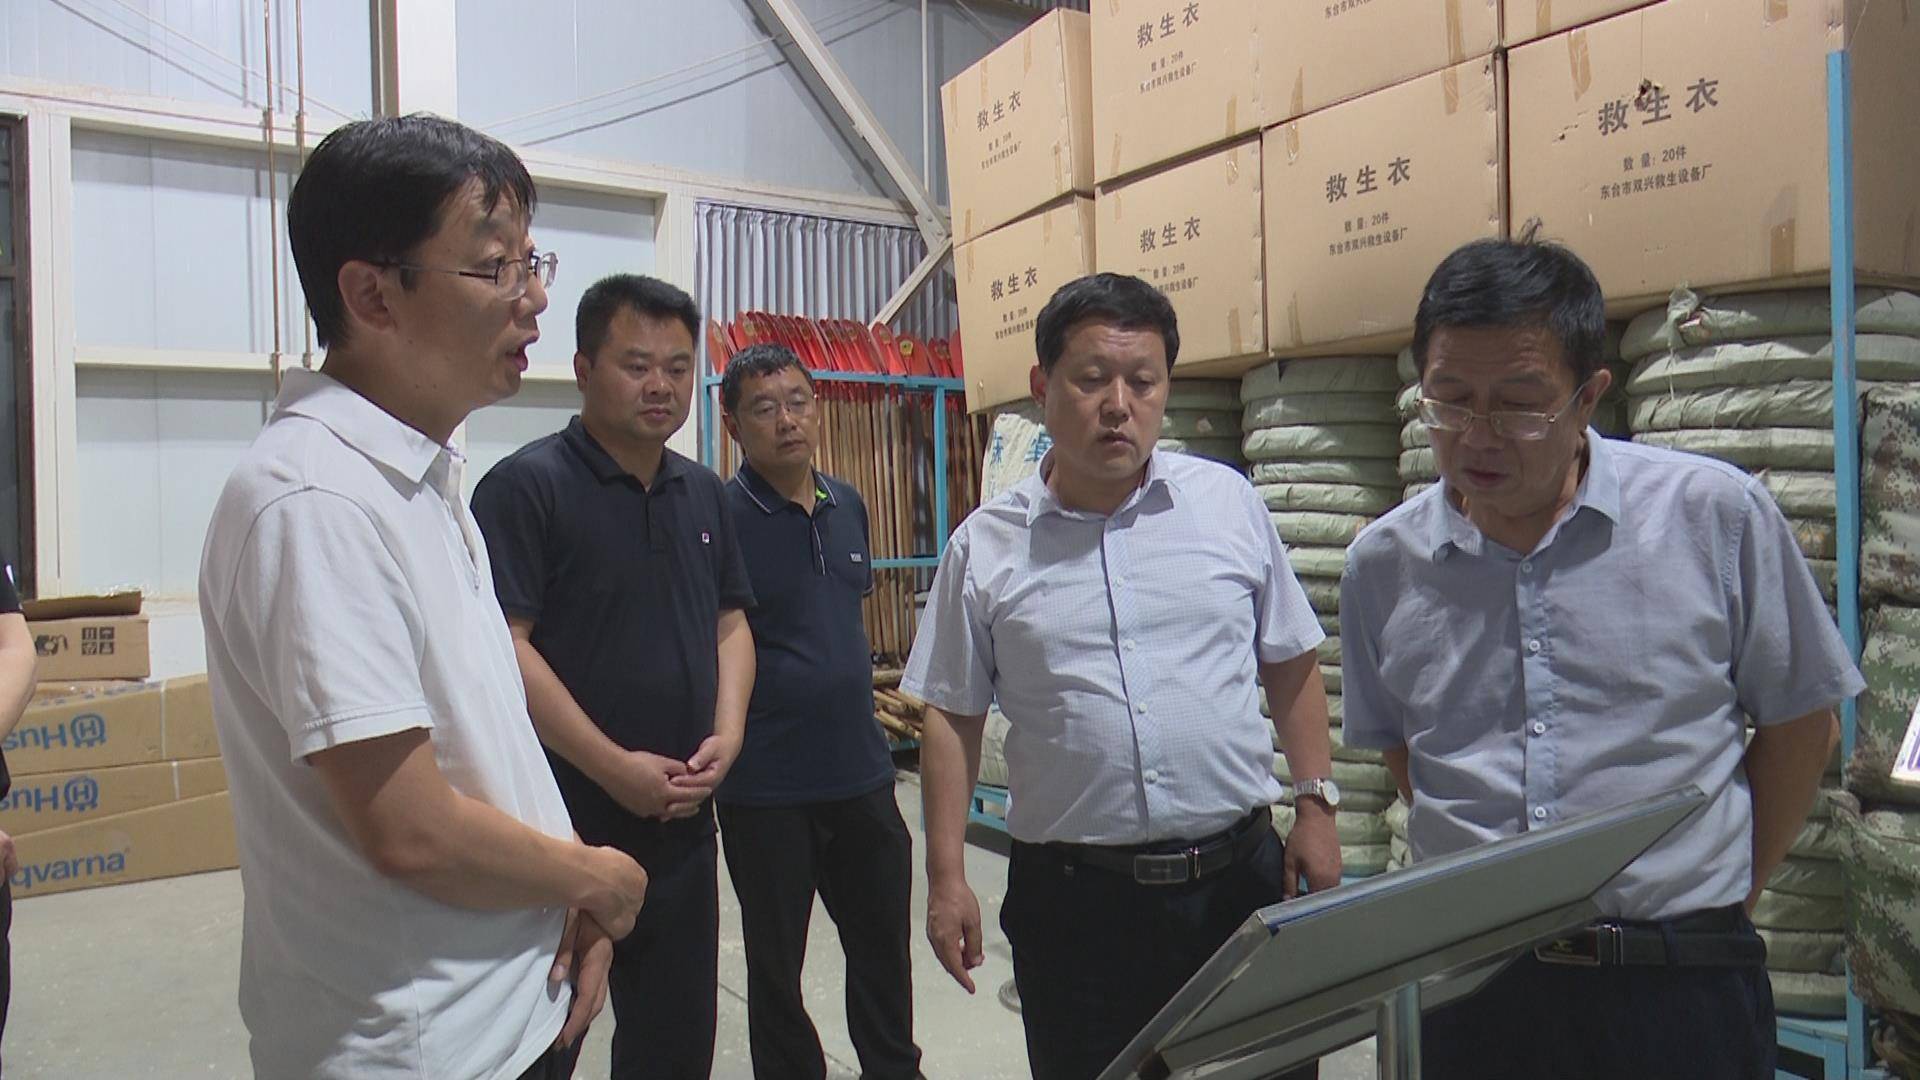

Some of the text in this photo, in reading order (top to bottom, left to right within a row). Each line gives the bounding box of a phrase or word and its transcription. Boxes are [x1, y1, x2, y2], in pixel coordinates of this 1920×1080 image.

[1137, 2, 1199, 48] 救生衣
[977, 90, 1021, 132] 救生衣
[1598, 78, 1718, 136] 救生衣
[1326, 157, 1410, 203] 救生衣
[1600, 163, 1712, 200] 东台市双兴救生设备厂
[1140, 216, 1200, 253] 救生衣
[991, 266, 1037, 301] 救生衣
